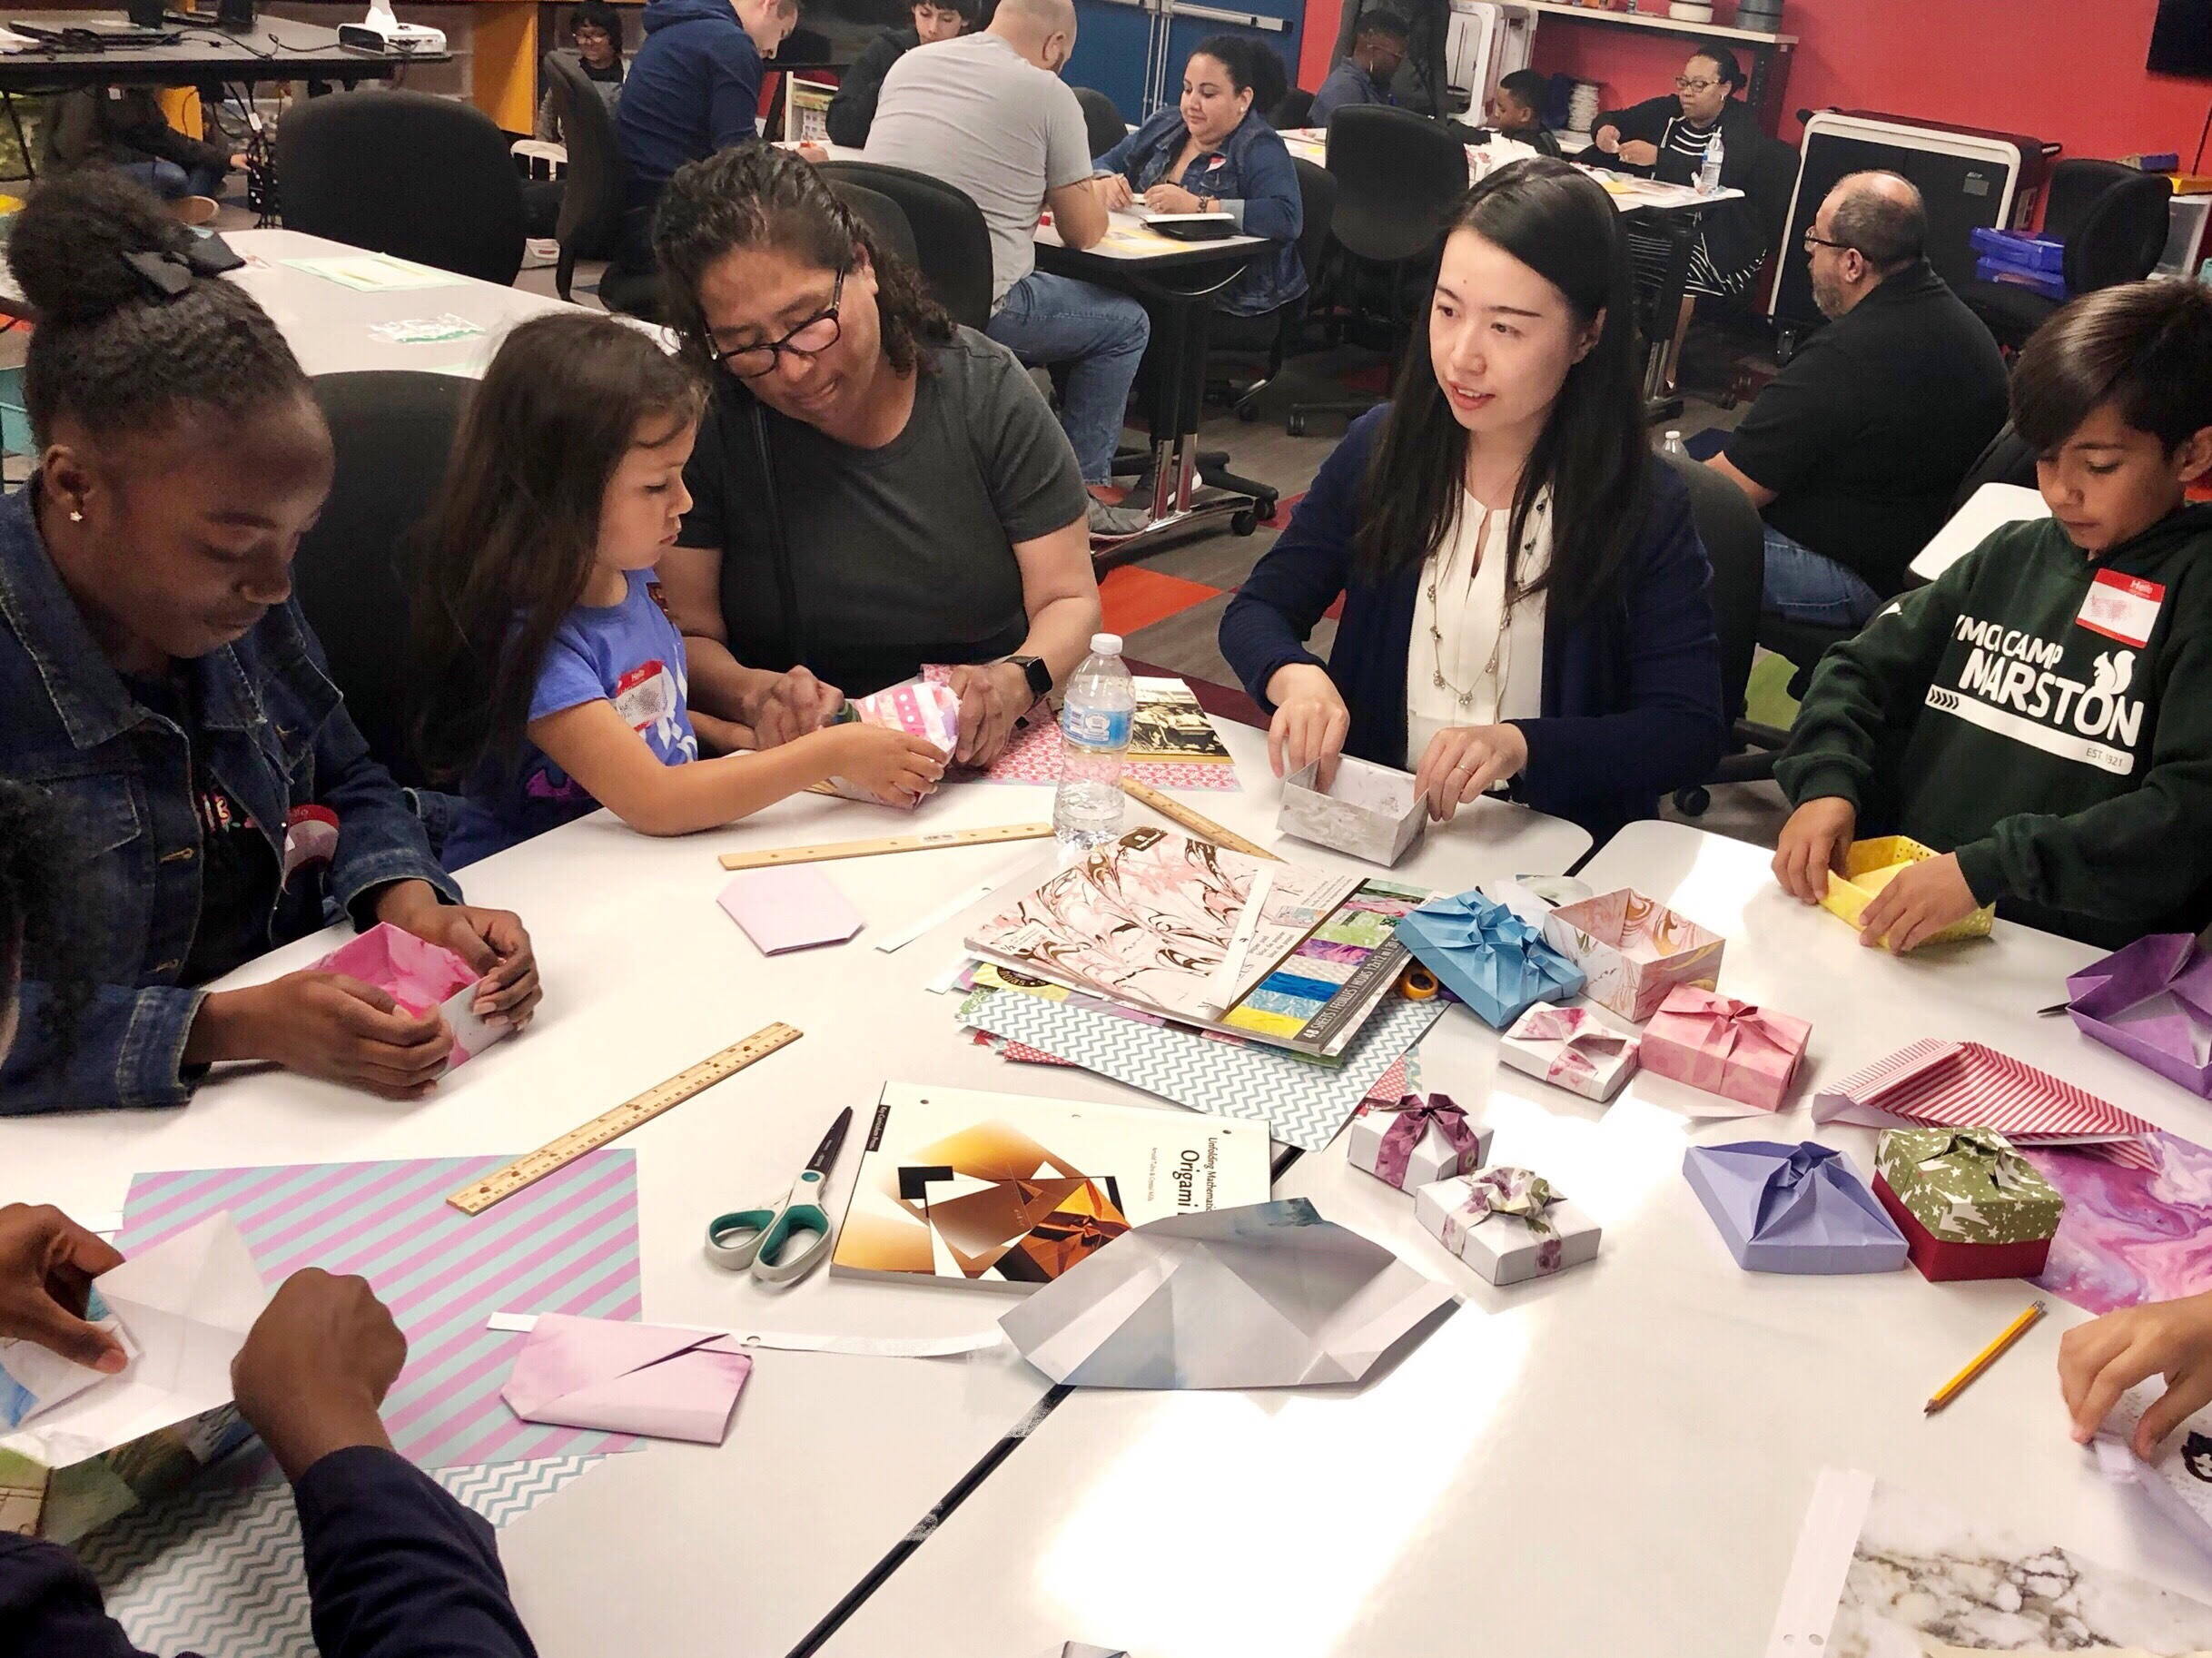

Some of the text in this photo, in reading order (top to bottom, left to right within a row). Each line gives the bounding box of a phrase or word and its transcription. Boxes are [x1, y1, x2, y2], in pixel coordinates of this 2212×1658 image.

[2002, 630, 2063, 670] CAMP
[1959, 648, 2144, 746] MARSTON
[1303, 1027, 1319, 1039] 48
[1310, 1010, 1337, 1031] SHEETS
[1203, 1137, 1219, 1169] Unfolding
[1172, 1150, 1200, 1208] Origami
